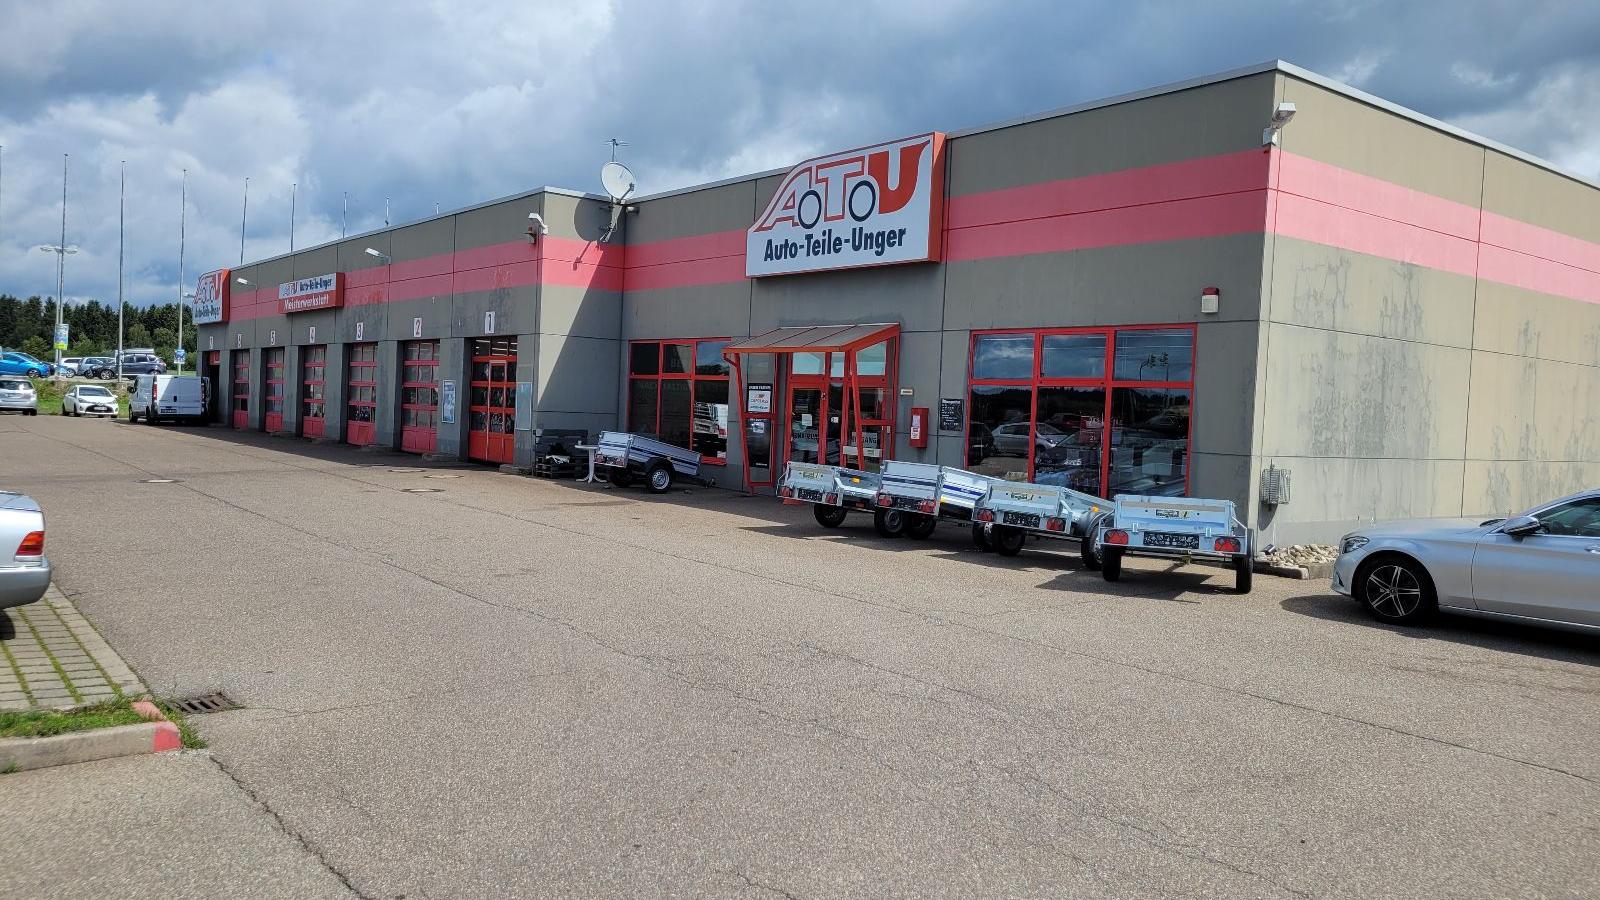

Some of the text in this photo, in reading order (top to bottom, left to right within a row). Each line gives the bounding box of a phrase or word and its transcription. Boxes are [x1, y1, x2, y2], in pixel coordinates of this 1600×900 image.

[763, 226, 907, 262] Auto-Teile-Unger
[284, 294, 329, 311] Meisterwerkstatt
[357, 324, 362, 338] 3
[415, 320, 421, 335] 2
[487, 314, 493, 331] 1
